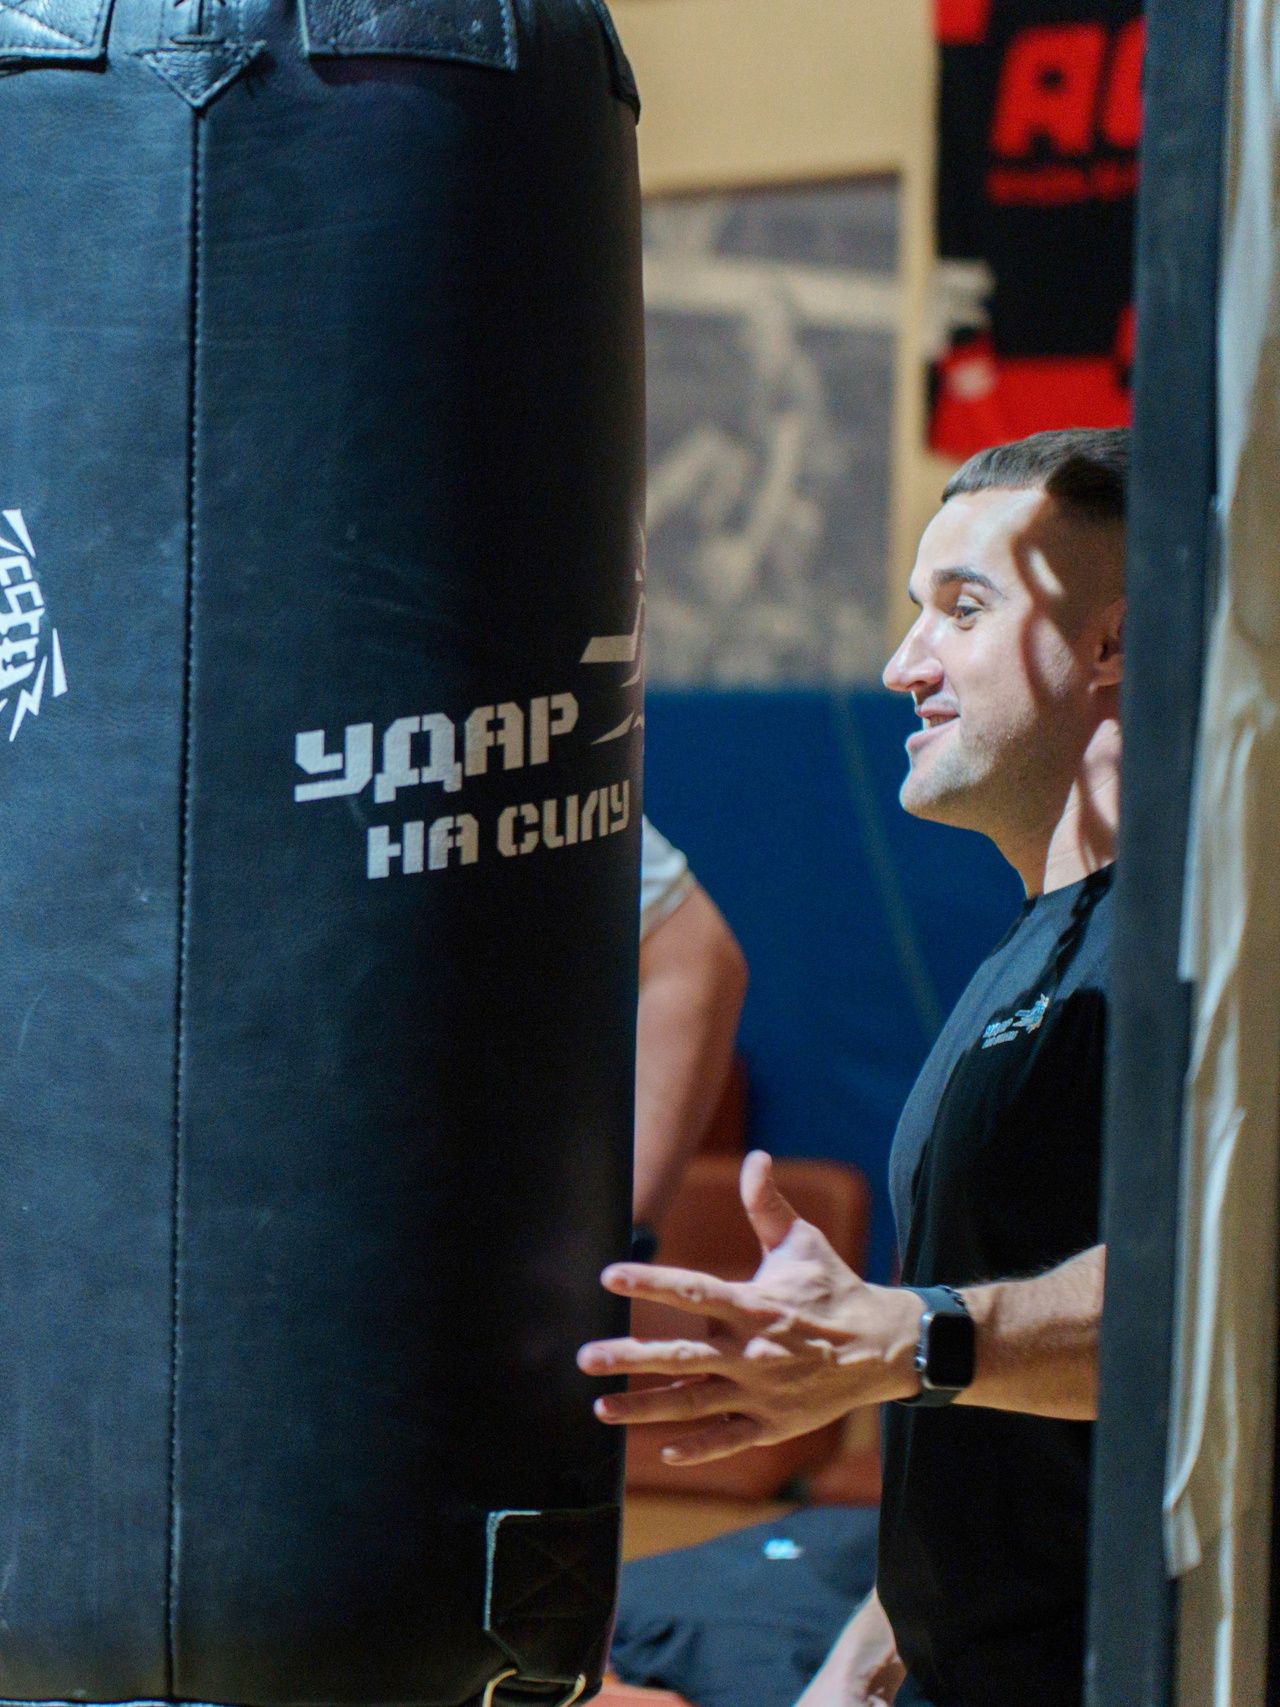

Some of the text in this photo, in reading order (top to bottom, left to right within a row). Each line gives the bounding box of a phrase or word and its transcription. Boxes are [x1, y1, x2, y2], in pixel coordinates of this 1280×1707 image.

[295, 692, 579, 804] УДАР
[367, 778, 630, 880] НА СИЛУ
